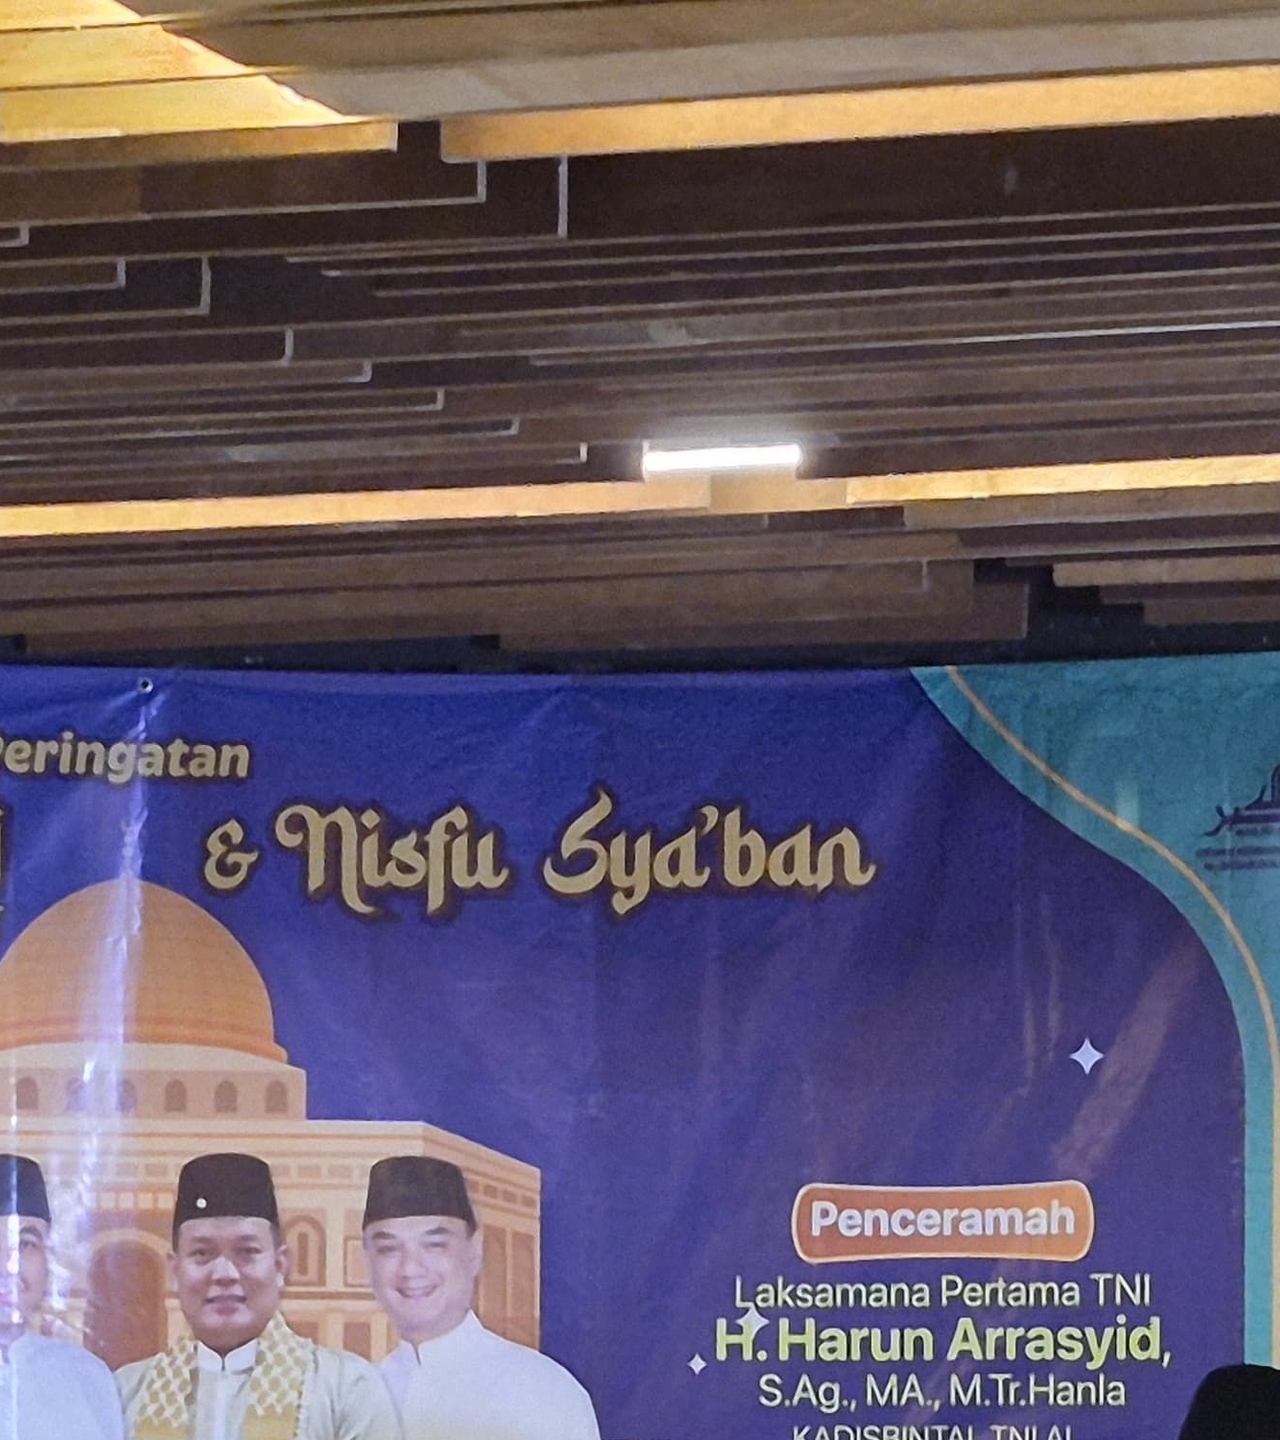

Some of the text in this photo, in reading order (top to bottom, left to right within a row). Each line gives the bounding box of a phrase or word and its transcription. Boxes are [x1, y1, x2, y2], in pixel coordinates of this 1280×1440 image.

[203, 789, 877, 916] & Nisfu Sya'ban
[811, 1200, 1076, 1239] Penceramah
[734, 1272, 1151, 1309] Laksamana Pertama TNI
[715, 1314, 1173, 1370] H. Harun Arrasyid,
[758, 1373, 1126, 1414] S.Ag., MA., M.Tr.Hanla
